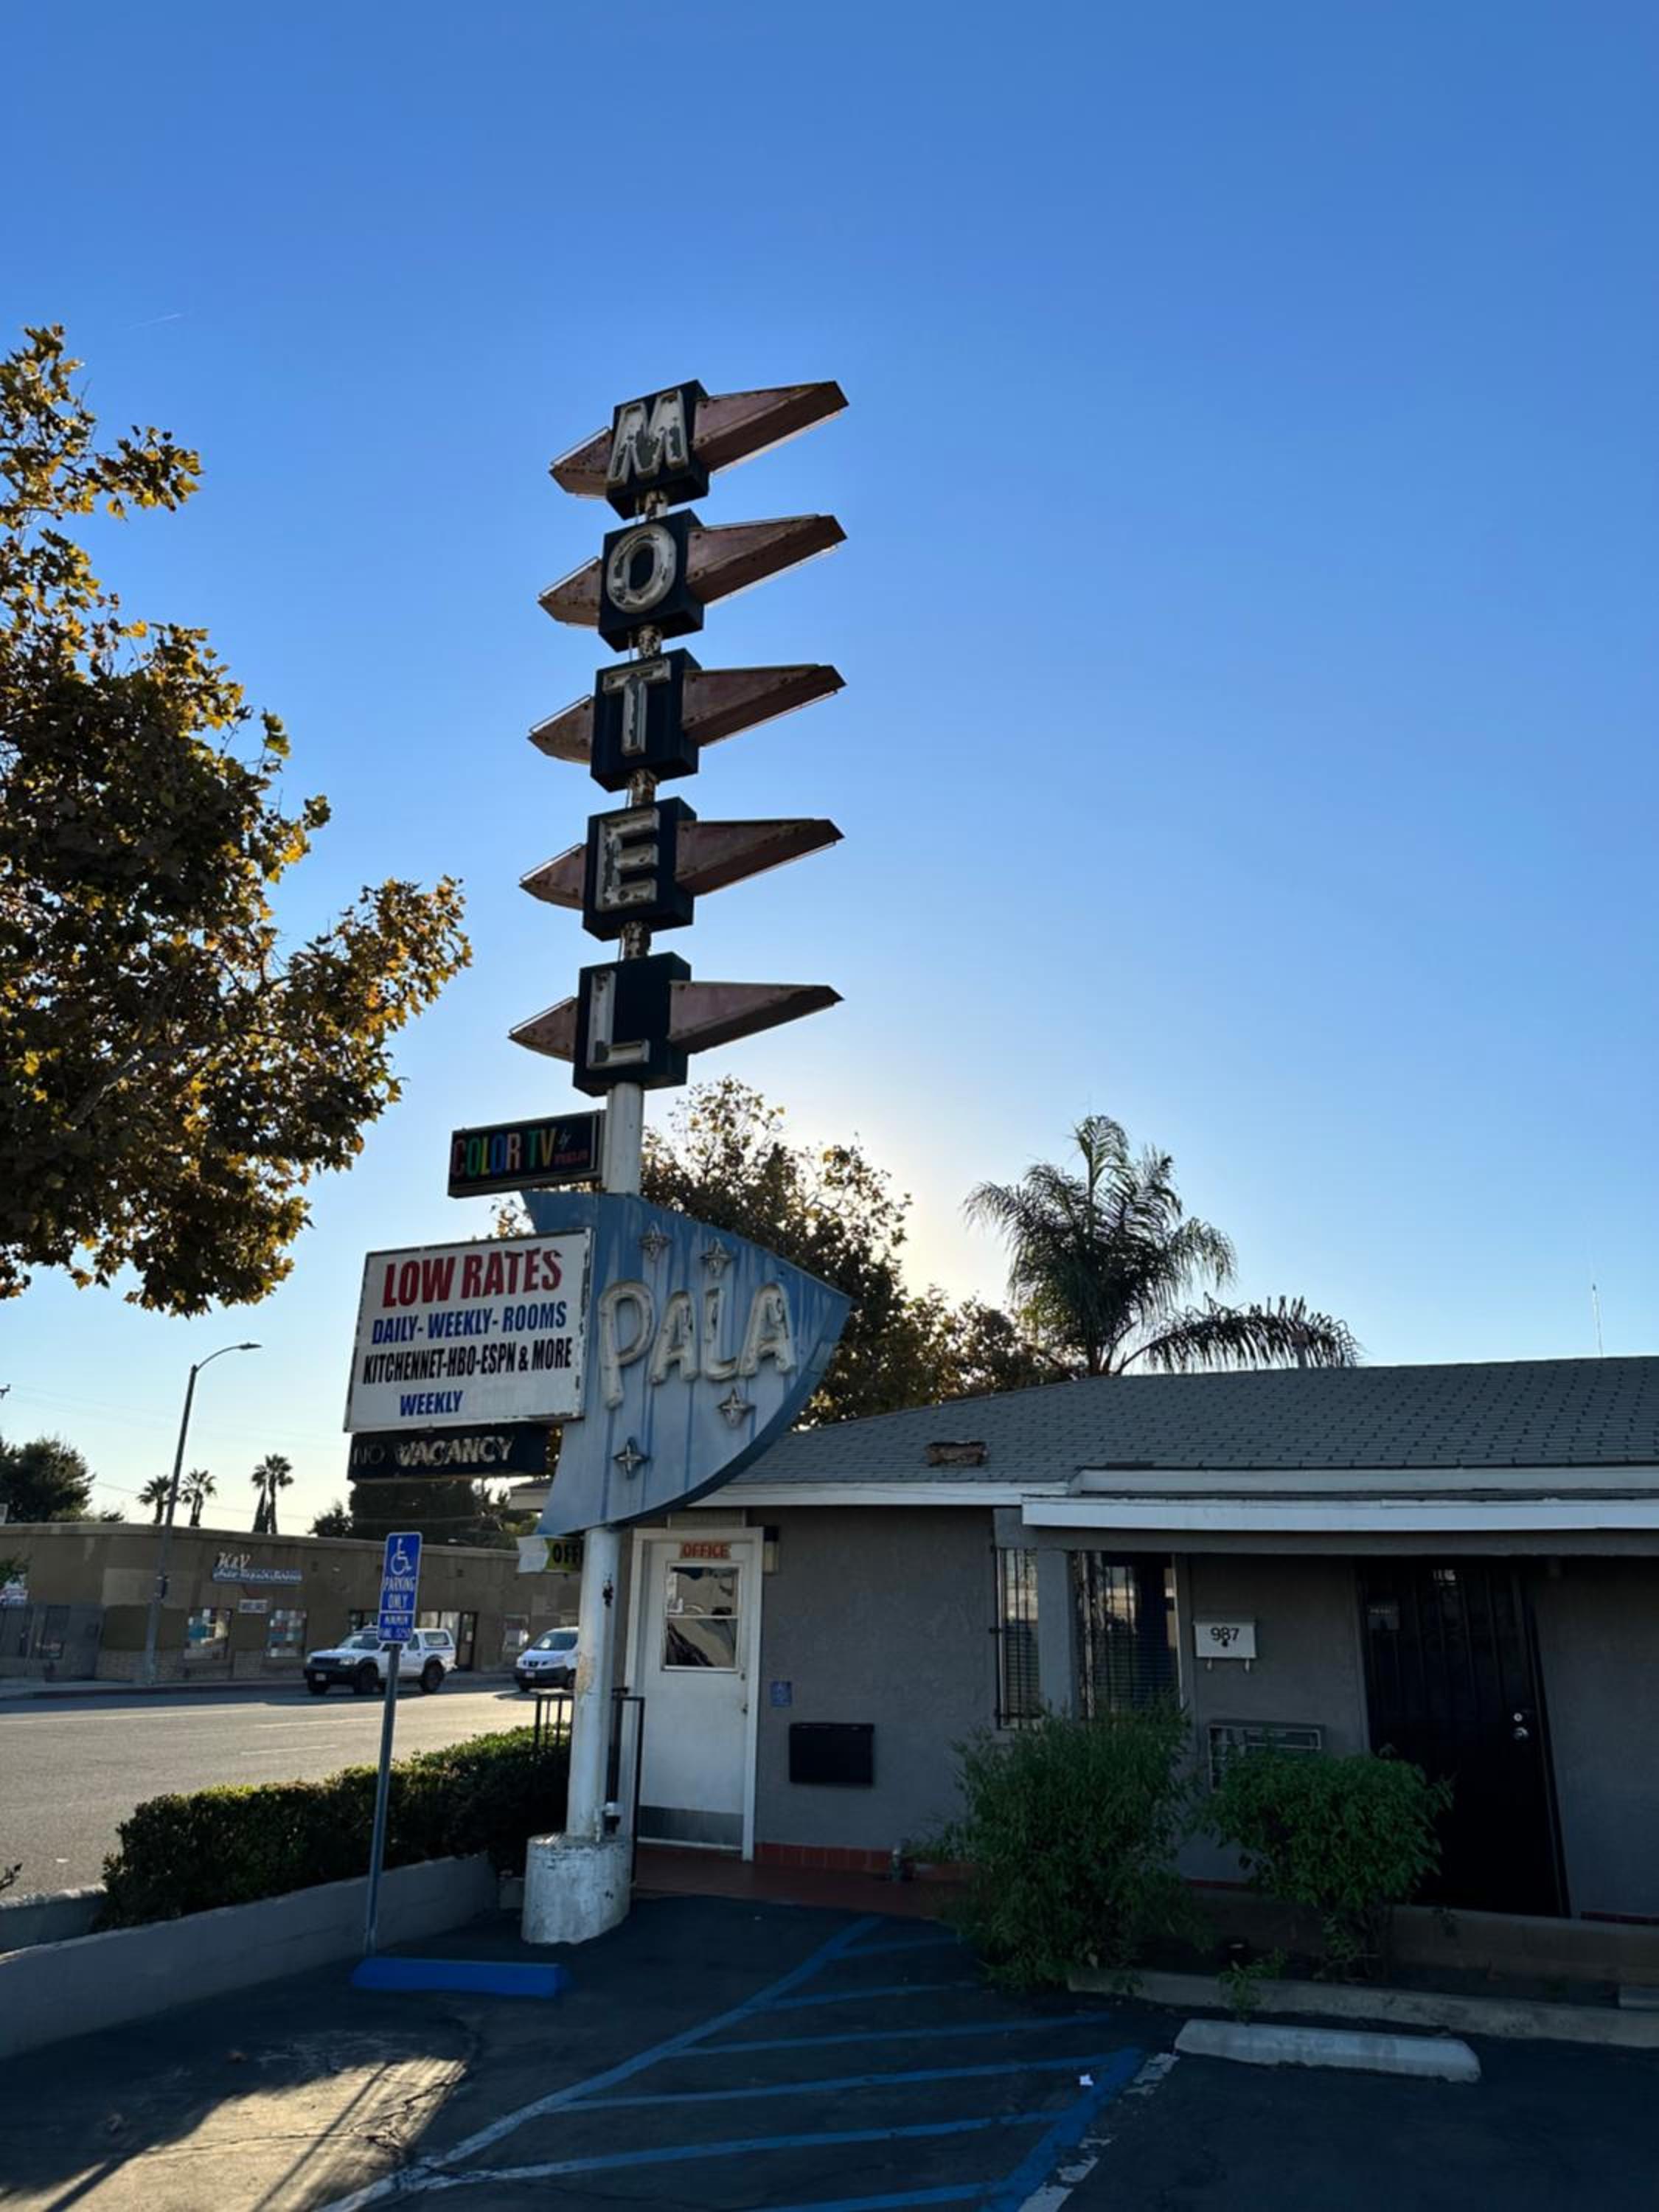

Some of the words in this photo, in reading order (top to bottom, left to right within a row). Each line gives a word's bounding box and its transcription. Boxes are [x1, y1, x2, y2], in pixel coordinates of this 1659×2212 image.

[586, 388, 690, 1069] MOTEL
[452, 1132, 522, 1178] COLOR
[527, 1127, 557, 1169] TV
[382, 1256, 456, 1308] LOW
[459, 1247, 563, 1299] RATES
[502, 1301, 568, 1333] ROOMS
[518, 1346, 529, 1372] &
[531, 1337, 574, 1371] MORE
[597, 1280, 796, 1410] PALA
[400, 1390, 465, 1417] WEEKLY
[353, 1443, 386, 1466] NO
[397, 1436, 514, 1467] VACANCY
[683, 1543, 730, 1559] OFFICE
[383, 1576, 416, 1593] PARKING
[387, 1593, 408, 1610] ONLY
[1210, 1626, 1239, 1641] 987
